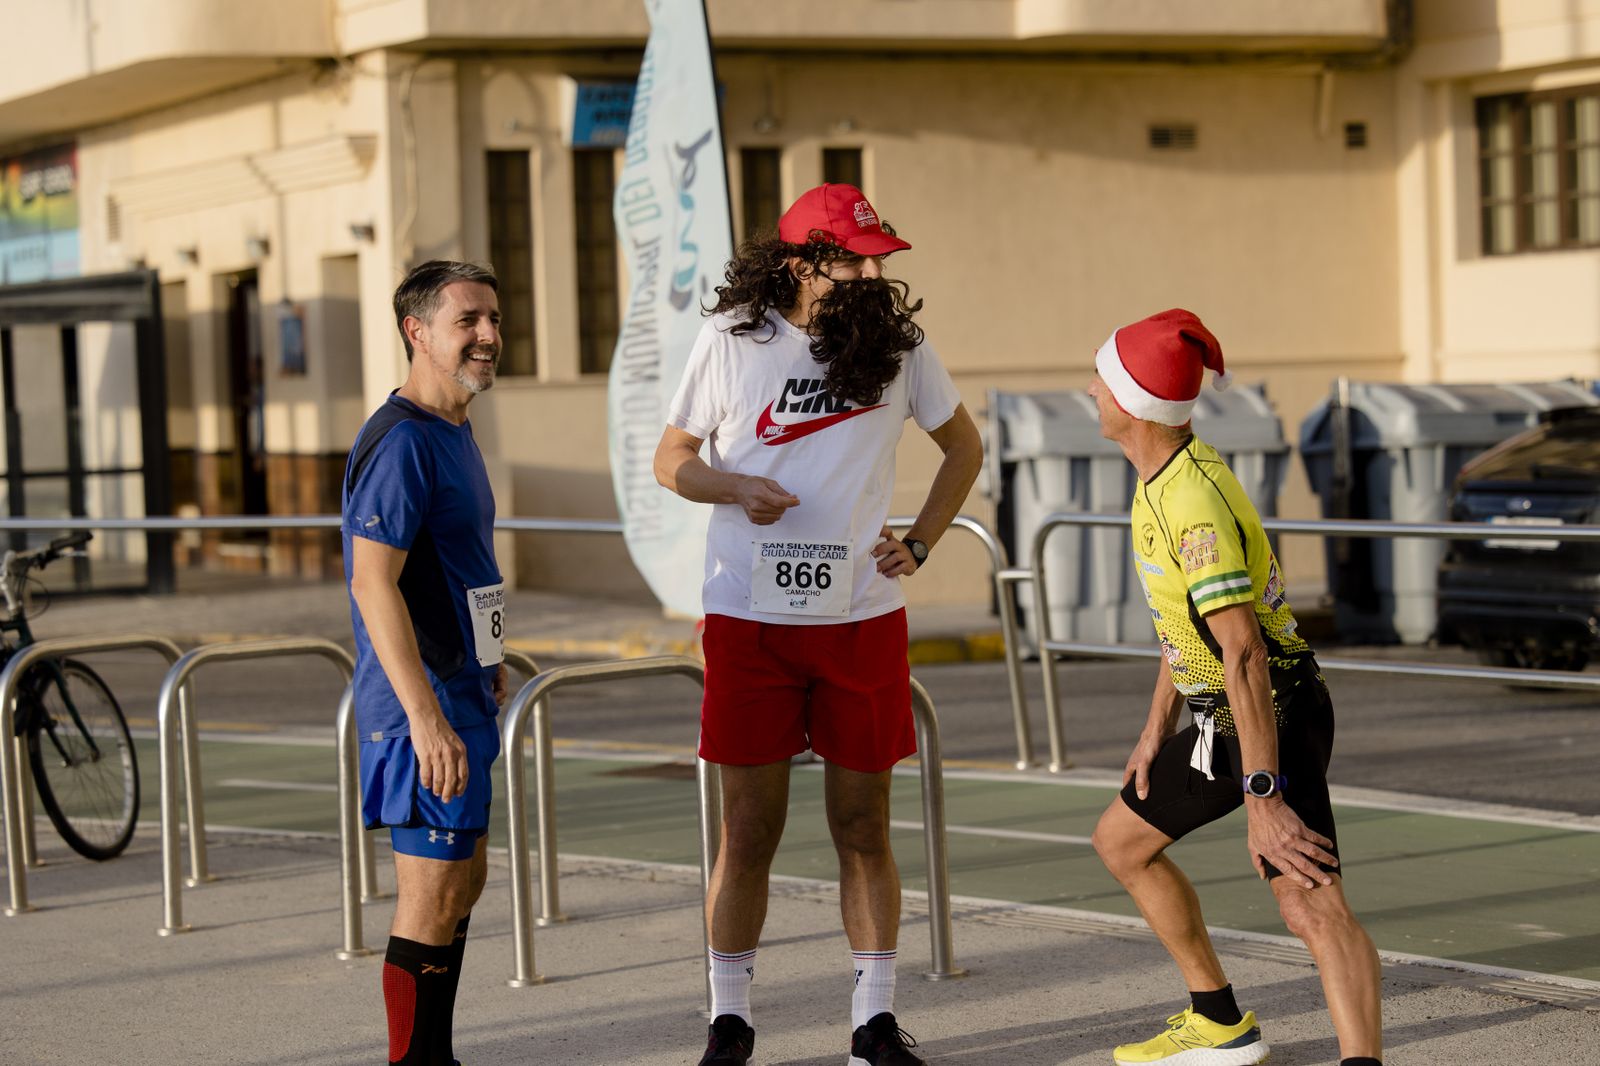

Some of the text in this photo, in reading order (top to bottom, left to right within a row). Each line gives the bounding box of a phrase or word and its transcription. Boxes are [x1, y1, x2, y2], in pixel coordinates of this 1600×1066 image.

[763, 425, 786, 436] NIKE
[787, 543, 848, 551] SILVESTRE
[761, 548, 800, 558] CIUDAD
[802, 550, 815, 559] DE
[775, 561, 832, 590] 866
[474, 592, 495, 601] SAN
